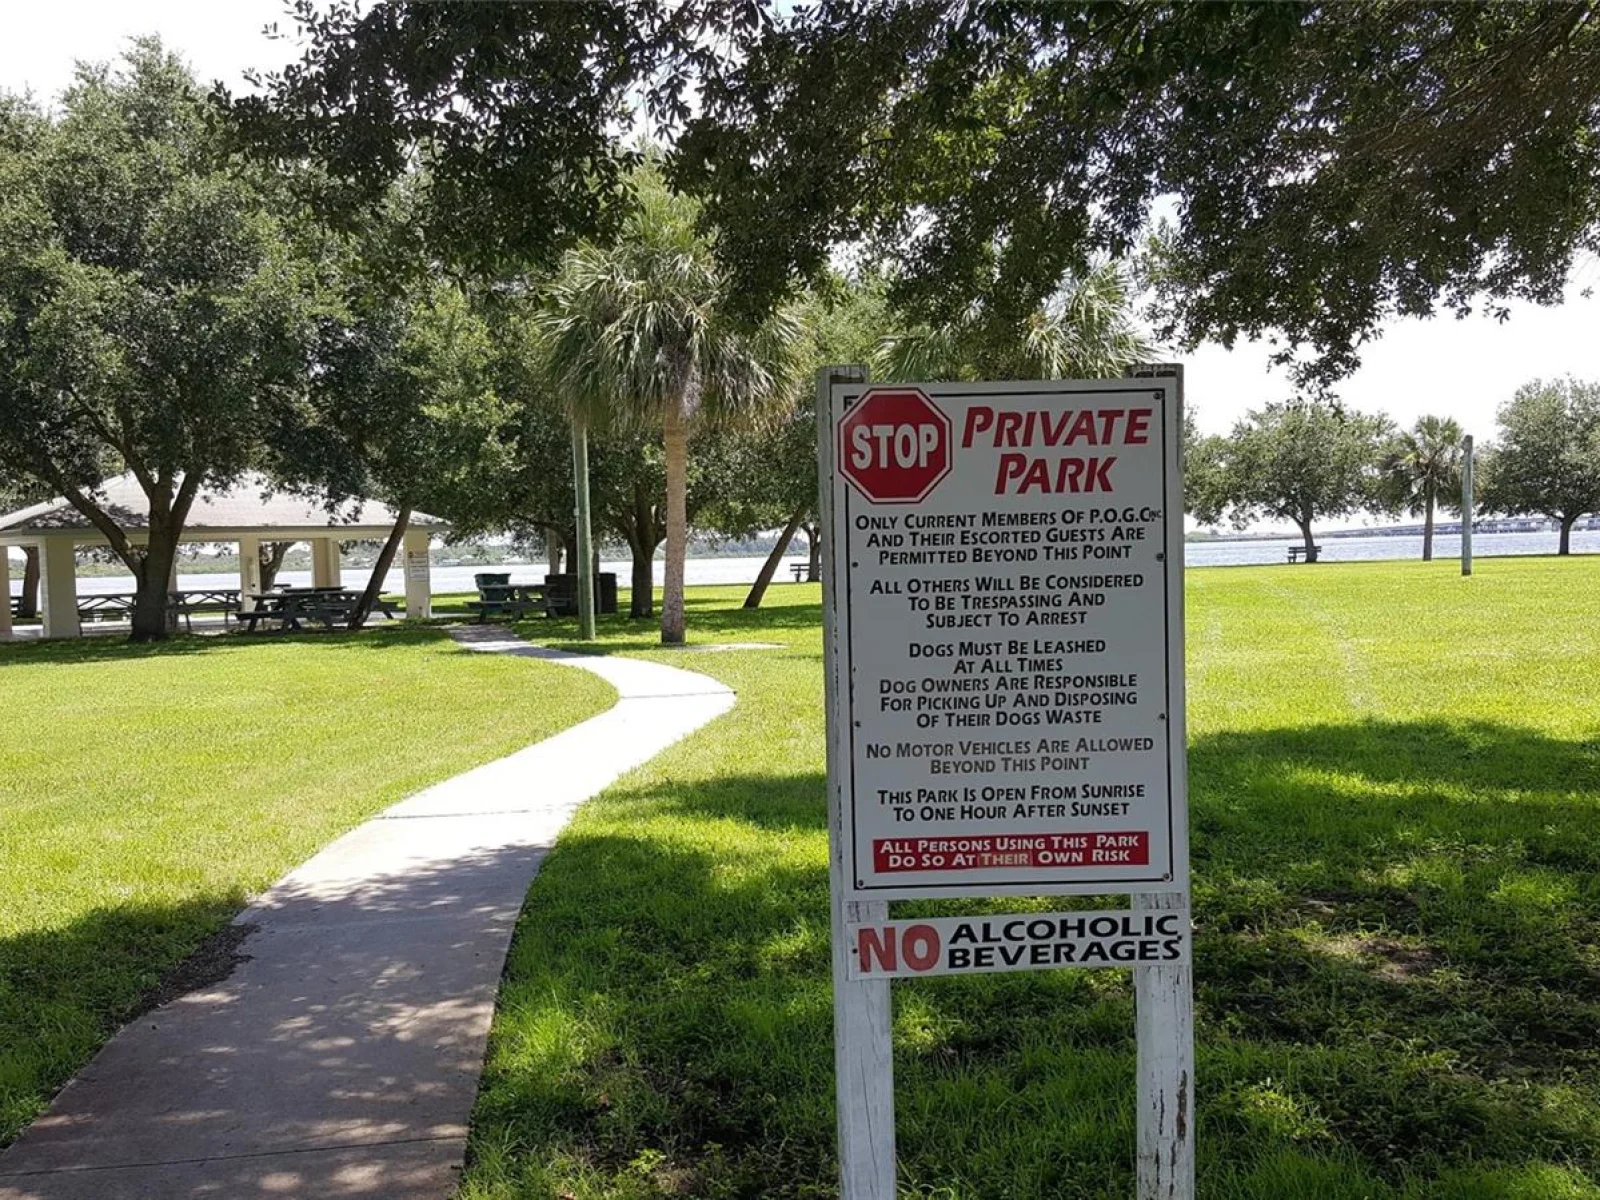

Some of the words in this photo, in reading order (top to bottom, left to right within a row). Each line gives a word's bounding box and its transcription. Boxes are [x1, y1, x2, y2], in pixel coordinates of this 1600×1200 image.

[962, 406, 1152, 448] PRIVATE
[852, 424, 938, 469] STOP
[995, 452, 1117, 494] PARK
[856, 515, 897, 530] ONLY
[905, 514, 976, 529] CURRENT
[982, 512, 1056, 526] MEMBERS
[1062, 510, 1084, 524] OF
[867, 534, 903, 547] AND
[909, 532, 954, 546] THEIR
[961, 530, 1041, 545] ESCORTED
[1046, 528, 1104, 542] GUESTS
[1111, 526, 1144, 540] ARE
[880, 551, 966, 565] PERMITTED
[973, 548, 1037, 562] BEYOND
[1043, 546, 1077, 560] THIS
[1083, 545, 1132, 559] POINT
[870, 580, 901, 594] ALL
[907, 579, 969, 593] OTHERS
[975, 577, 1014, 591] WILL
[1021, 576, 1040, 590] BE
[1046, 574, 1143, 589] CONSIDERED
[908, 597, 929, 610] TO
[936, 596, 954, 610] BE
[961, 594, 1061, 609] TRESPASSING
[1068, 592, 1105, 606] AND
[927, 614, 992, 628] SUBJECT
[998, 612, 1019, 626] TO
[1026, 611, 1087, 625] ARREST
[910, 643, 953, 657] DOGS
[959, 642, 1002, 656] MUST
[1009, 641, 1028, 654] BE
[1034, 640, 1105, 654] LEASHED
[954, 660, 975, 674] AT
[981, 659, 1012, 673] ALL
[1017, 658, 1062, 672] TIMES
[880, 680, 915, 693] DOG
[922, 678, 989, 692] OWNERS
[995, 676, 1028, 690] ARE
[1034, 674, 1136, 689] RESPONSIBLE
[881, 697, 911, 711] FOR
[918, 696, 980, 710] PICKING
[986, 694, 1006, 708] UP
[1013, 693, 1049, 707] AND
[1055, 692, 1137, 706] DISPOSING
[917, 714, 938, 728] OF
[945, 713, 990, 727] THEIR
[997, 711, 1040, 725] DOGS
[1046, 710, 1101, 724] WASTE
[867, 744, 890, 758] NO
[897, 743, 953, 757] MOTOR
[959, 741, 1030, 755] VEHICLES
[1037, 739, 1069, 753] ARE
[1076, 738, 1153, 752] ALLOWED
[931, 760, 995, 774] BEYOND
[1001, 758, 1035, 771] THIS
[1041, 757, 1089, 770] POINT
[878, 790, 911, 804] THIS
[918, 789, 957, 803] PARK
[964, 788, 976, 801] IS
[983, 787, 1025, 801] OPEN
[1031, 786, 1076, 800] FROM
[1082, 784, 1144, 798] SUNRISE
[894, 807, 914, 821] TO
[921, 806, 954, 821] ONE
[961, 805, 1006, 819] HOUR
[1013, 804, 1065, 818] AFTER
[1072, 802, 1129, 816] SUNSET
[881, 841, 912, 853] ALL
[918, 840, 990, 852] PERSONS
[997, 838, 1045, 850] USING
[1051, 837, 1087, 849] THIS
[1097, 835, 1138, 847] PARK
[889, 855, 915, 867] DO
[922, 854, 944, 866] SO
[952, 854, 975, 865] AT
[981, 853, 1028, 865] THEIR
[1038, 851, 1082, 863] OWN
[1093, 849, 1129, 861] RISK
[948, 915, 1179, 944] ALCOHOLIC
[858, 925, 939, 971] NO
[948, 939, 1181, 968] BEVERAGES
